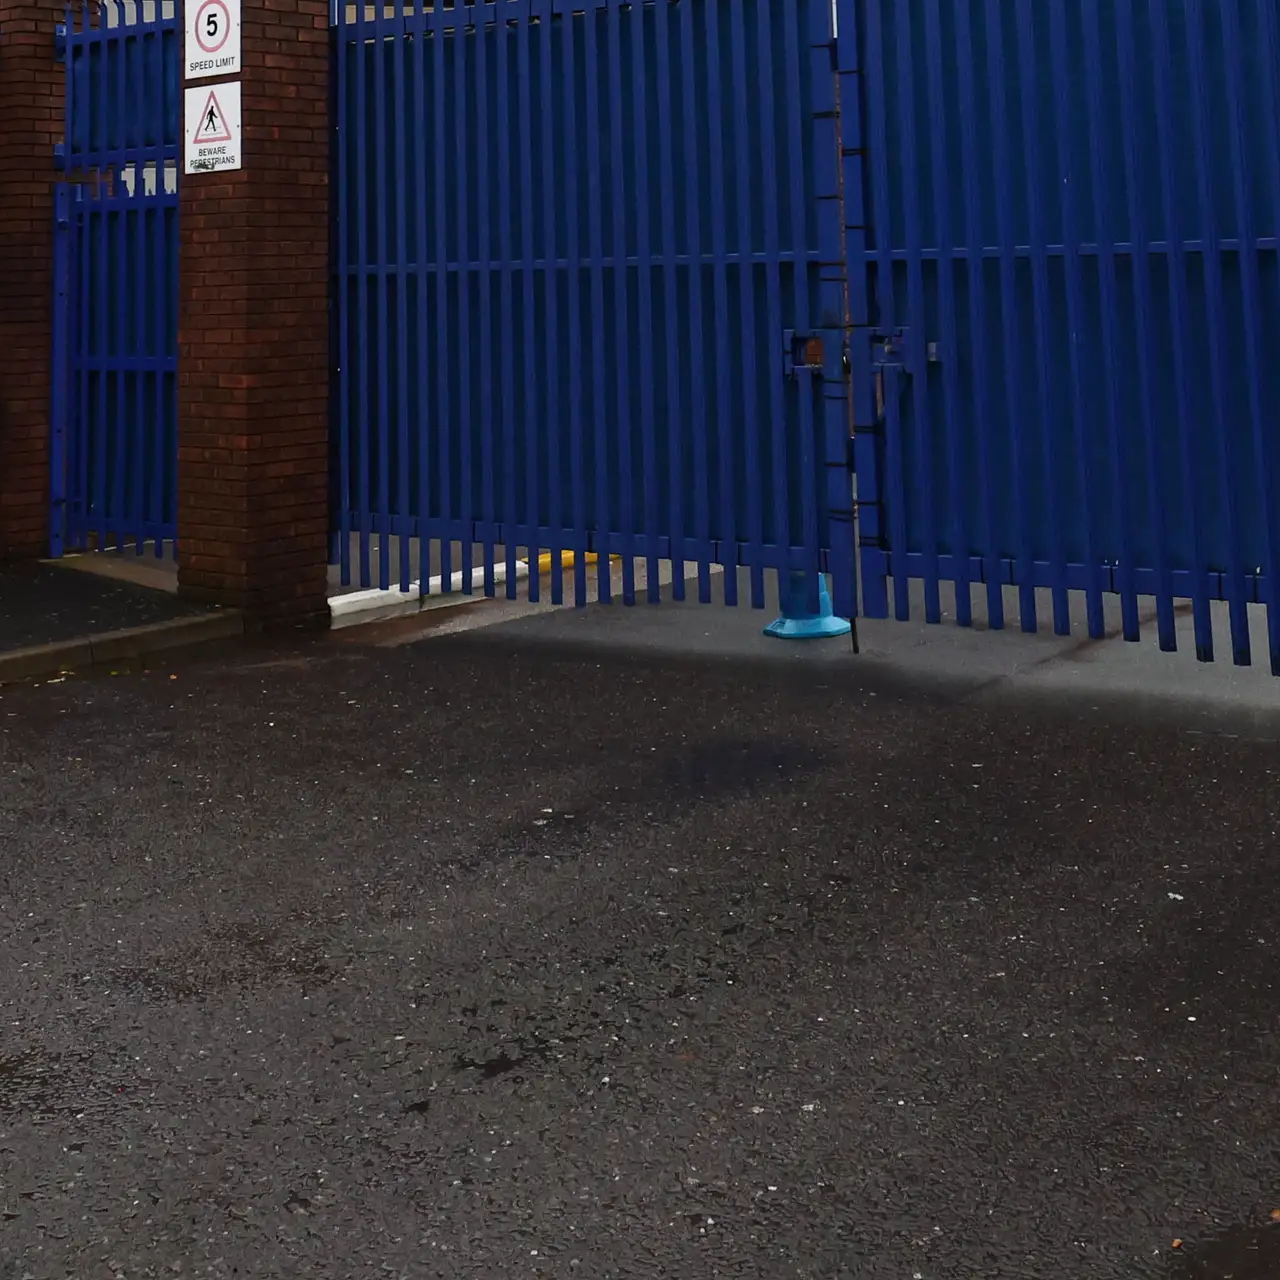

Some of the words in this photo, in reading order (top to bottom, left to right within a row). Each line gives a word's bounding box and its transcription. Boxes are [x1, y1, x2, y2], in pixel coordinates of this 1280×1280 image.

[206, 13, 218, 37] 5
[190, 59, 214, 71] SPEED
[216, 56, 235, 68] LIMIT
[198, 146, 227, 157] BEWARE
